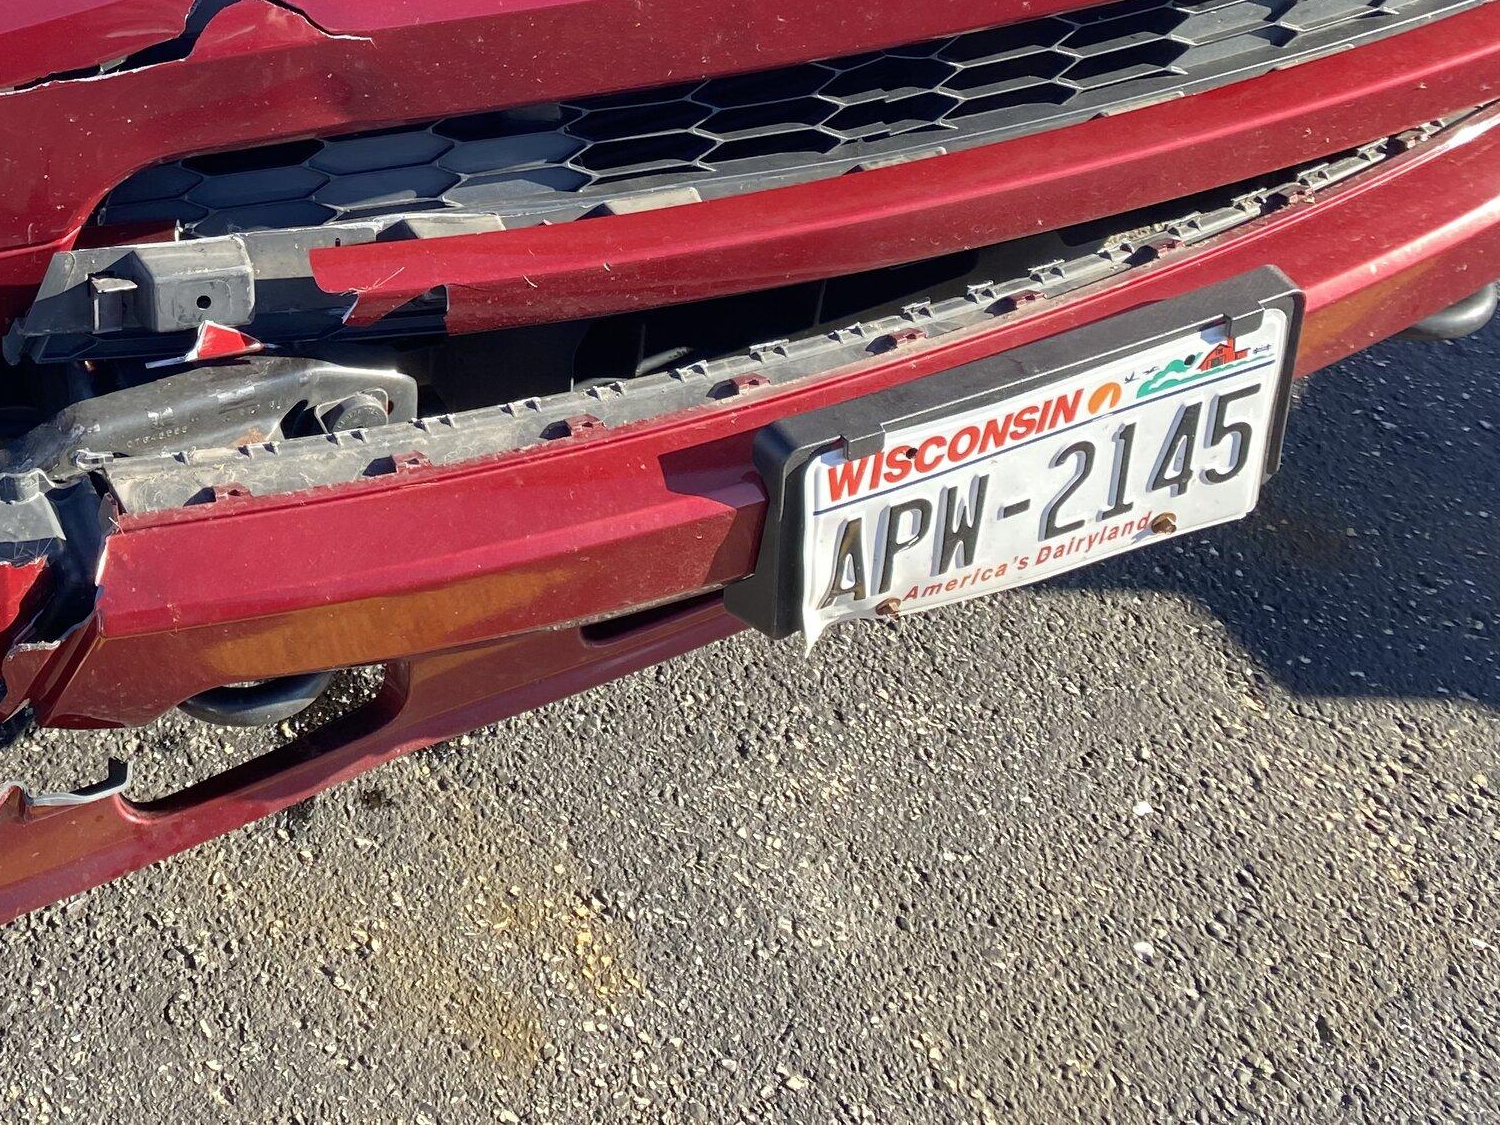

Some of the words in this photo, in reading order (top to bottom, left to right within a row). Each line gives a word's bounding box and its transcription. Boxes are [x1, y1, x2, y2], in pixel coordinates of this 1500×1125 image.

[819, 383, 1262, 610] APW-2145
[827, 388, 1083, 502] WISCONSIN
[903, 551, 1030, 602] America's
[1036, 511, 1150, 566] Dairyland
